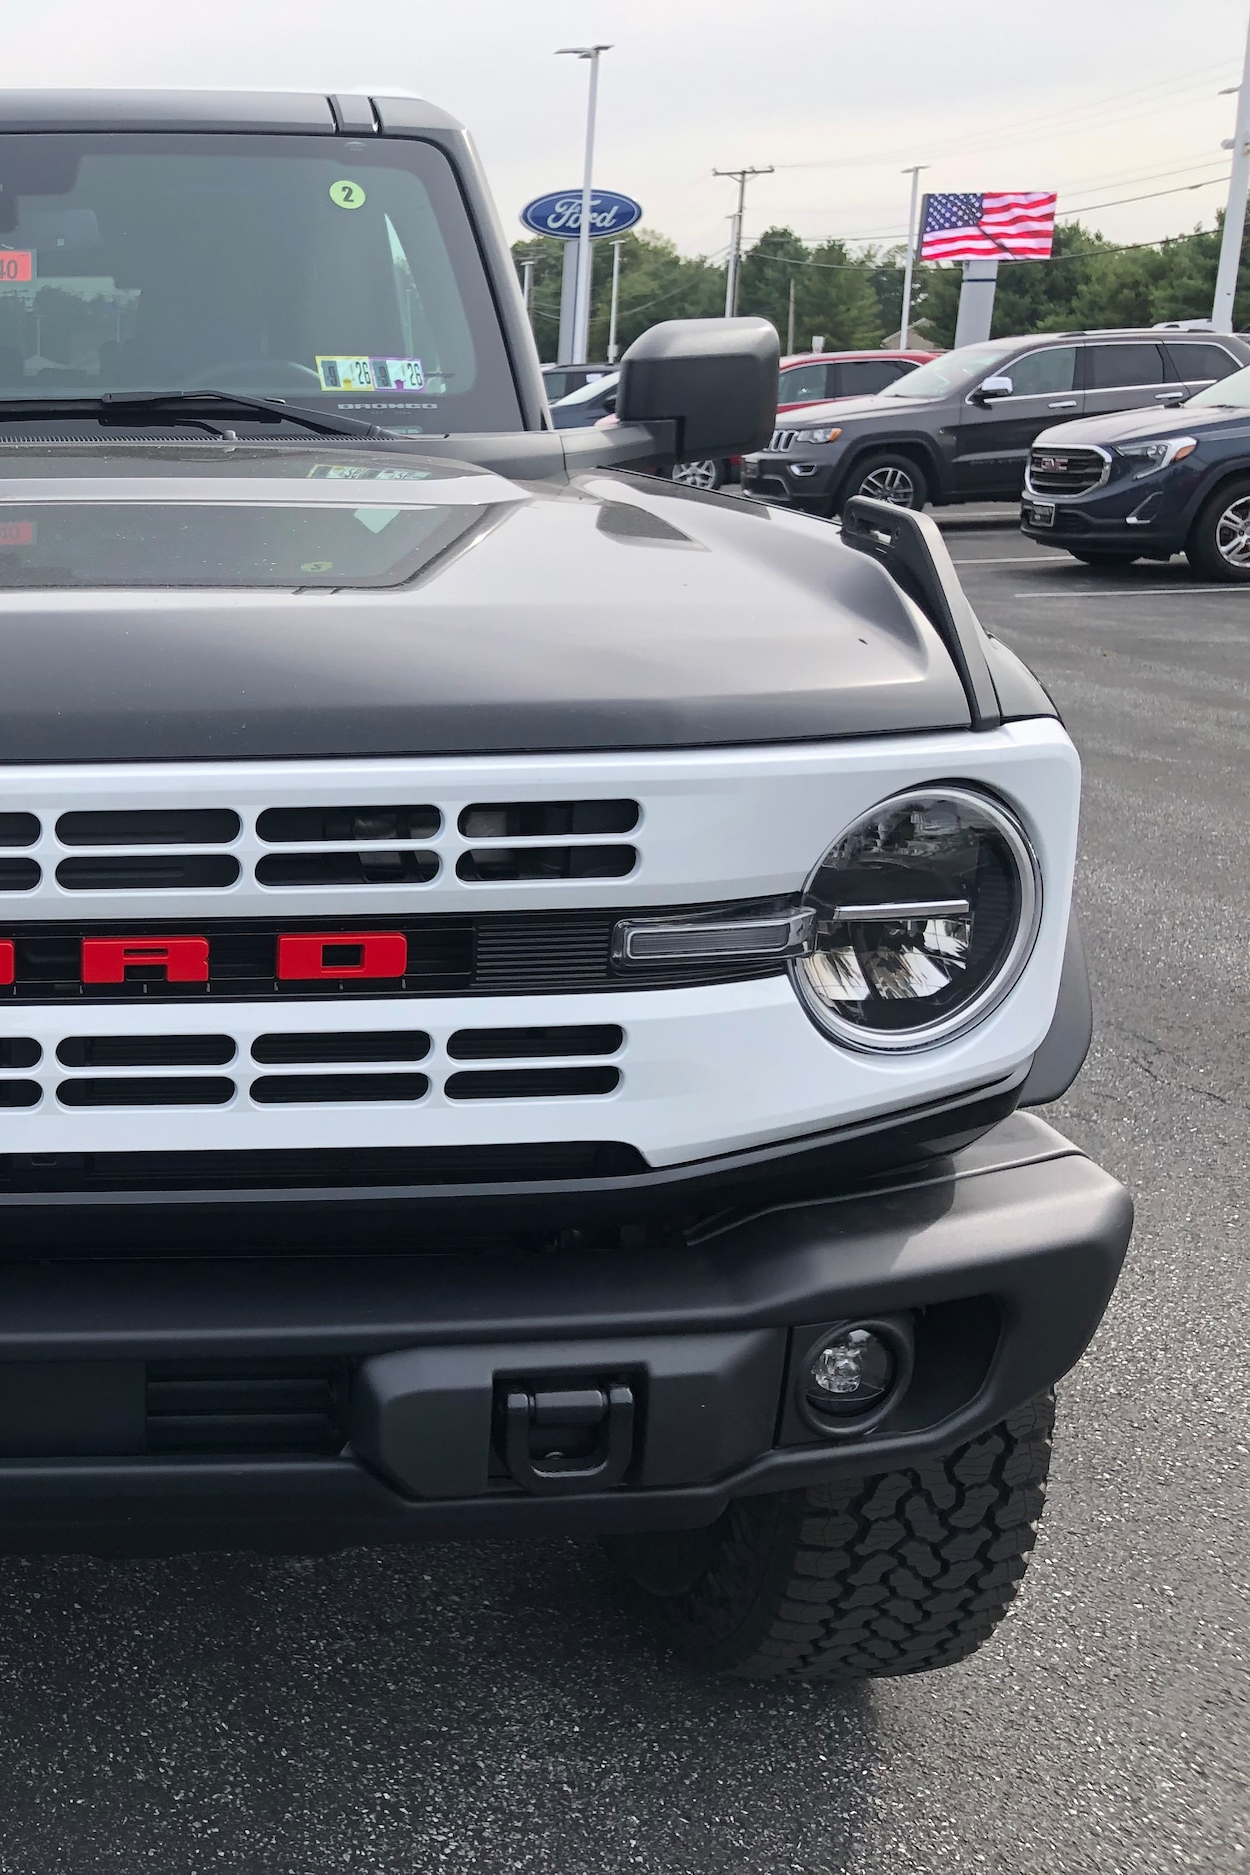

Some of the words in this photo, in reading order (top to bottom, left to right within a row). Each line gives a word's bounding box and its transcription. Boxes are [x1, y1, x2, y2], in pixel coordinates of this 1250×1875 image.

[341, 186, 354, 202] 2
[355, 361, 371, 384] 26
[406, 363, 423, 386] 26
